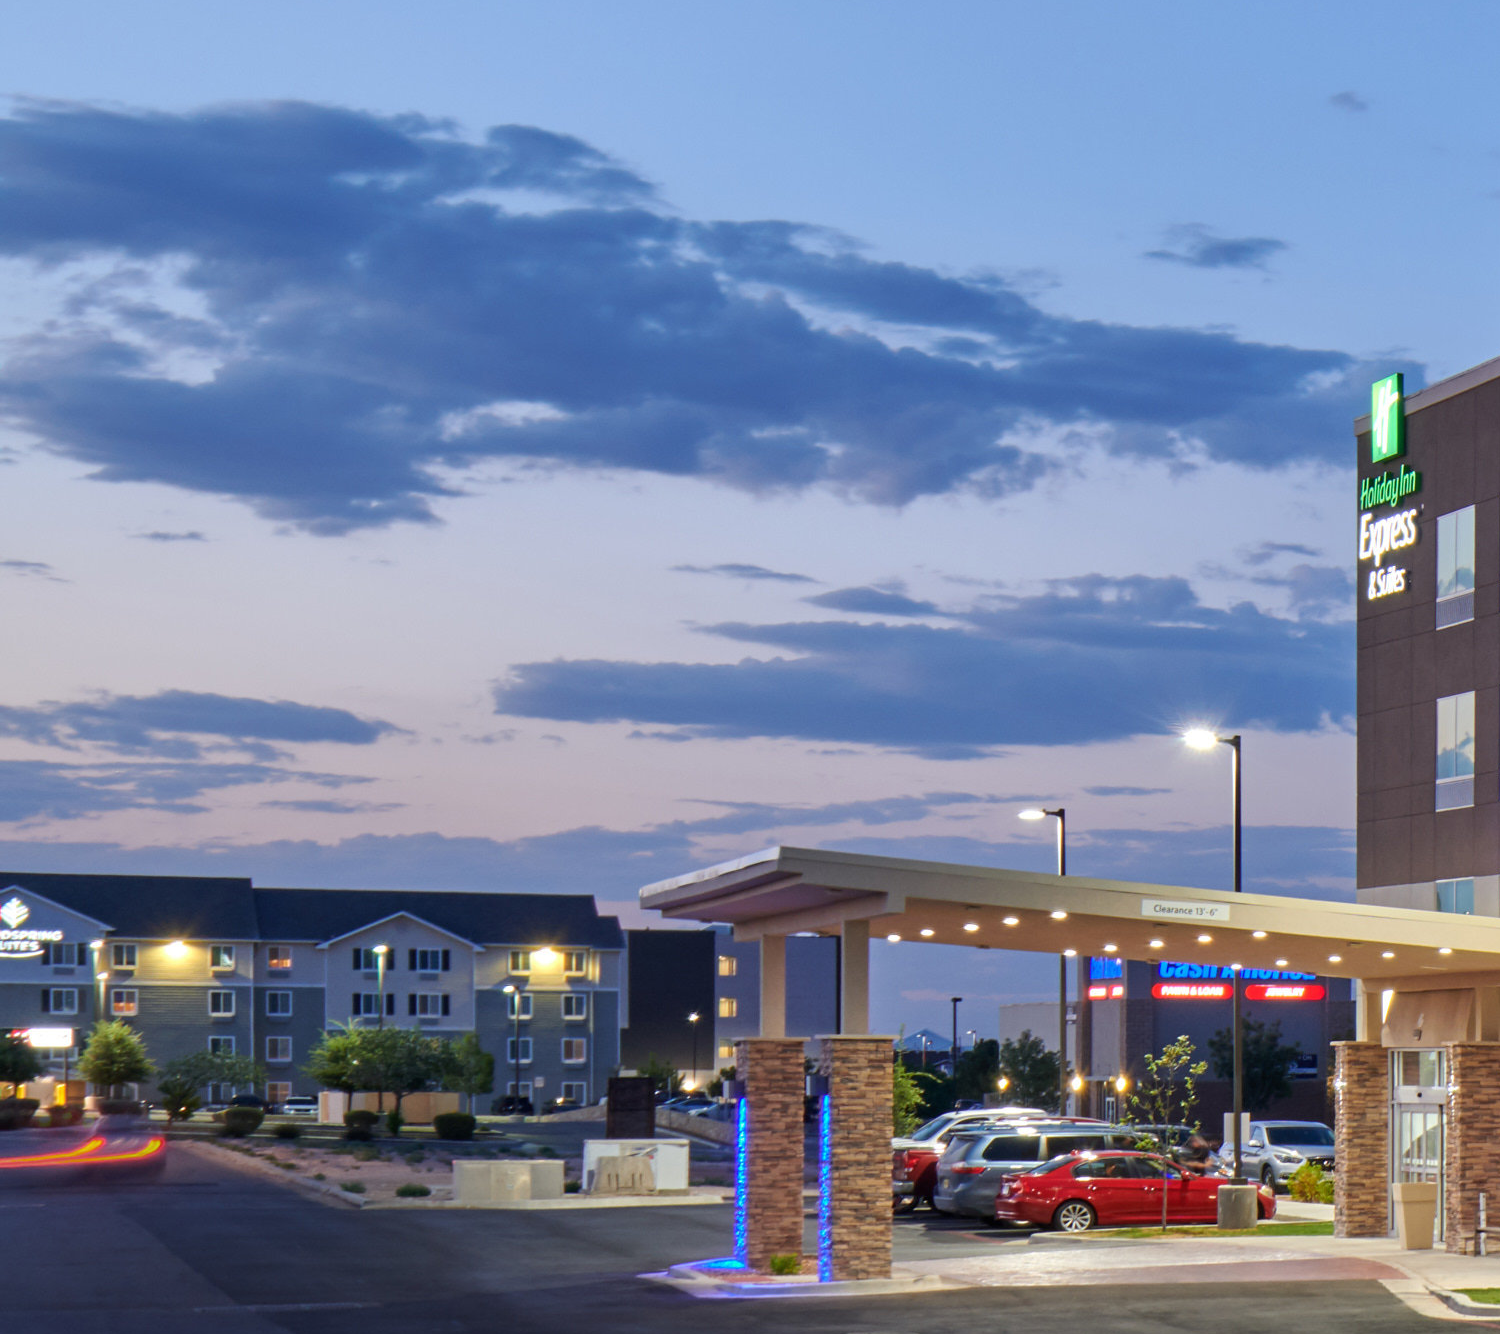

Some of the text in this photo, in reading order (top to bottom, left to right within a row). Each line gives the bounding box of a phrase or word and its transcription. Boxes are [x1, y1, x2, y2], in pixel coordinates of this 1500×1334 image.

[1360, 464, 1416, 510] Holiday Inn
[1359, 509, 1417, 567] Express
[1368, 566, 1406, 600] & Suites
[1153, 904, 1193, 915] Clearance
